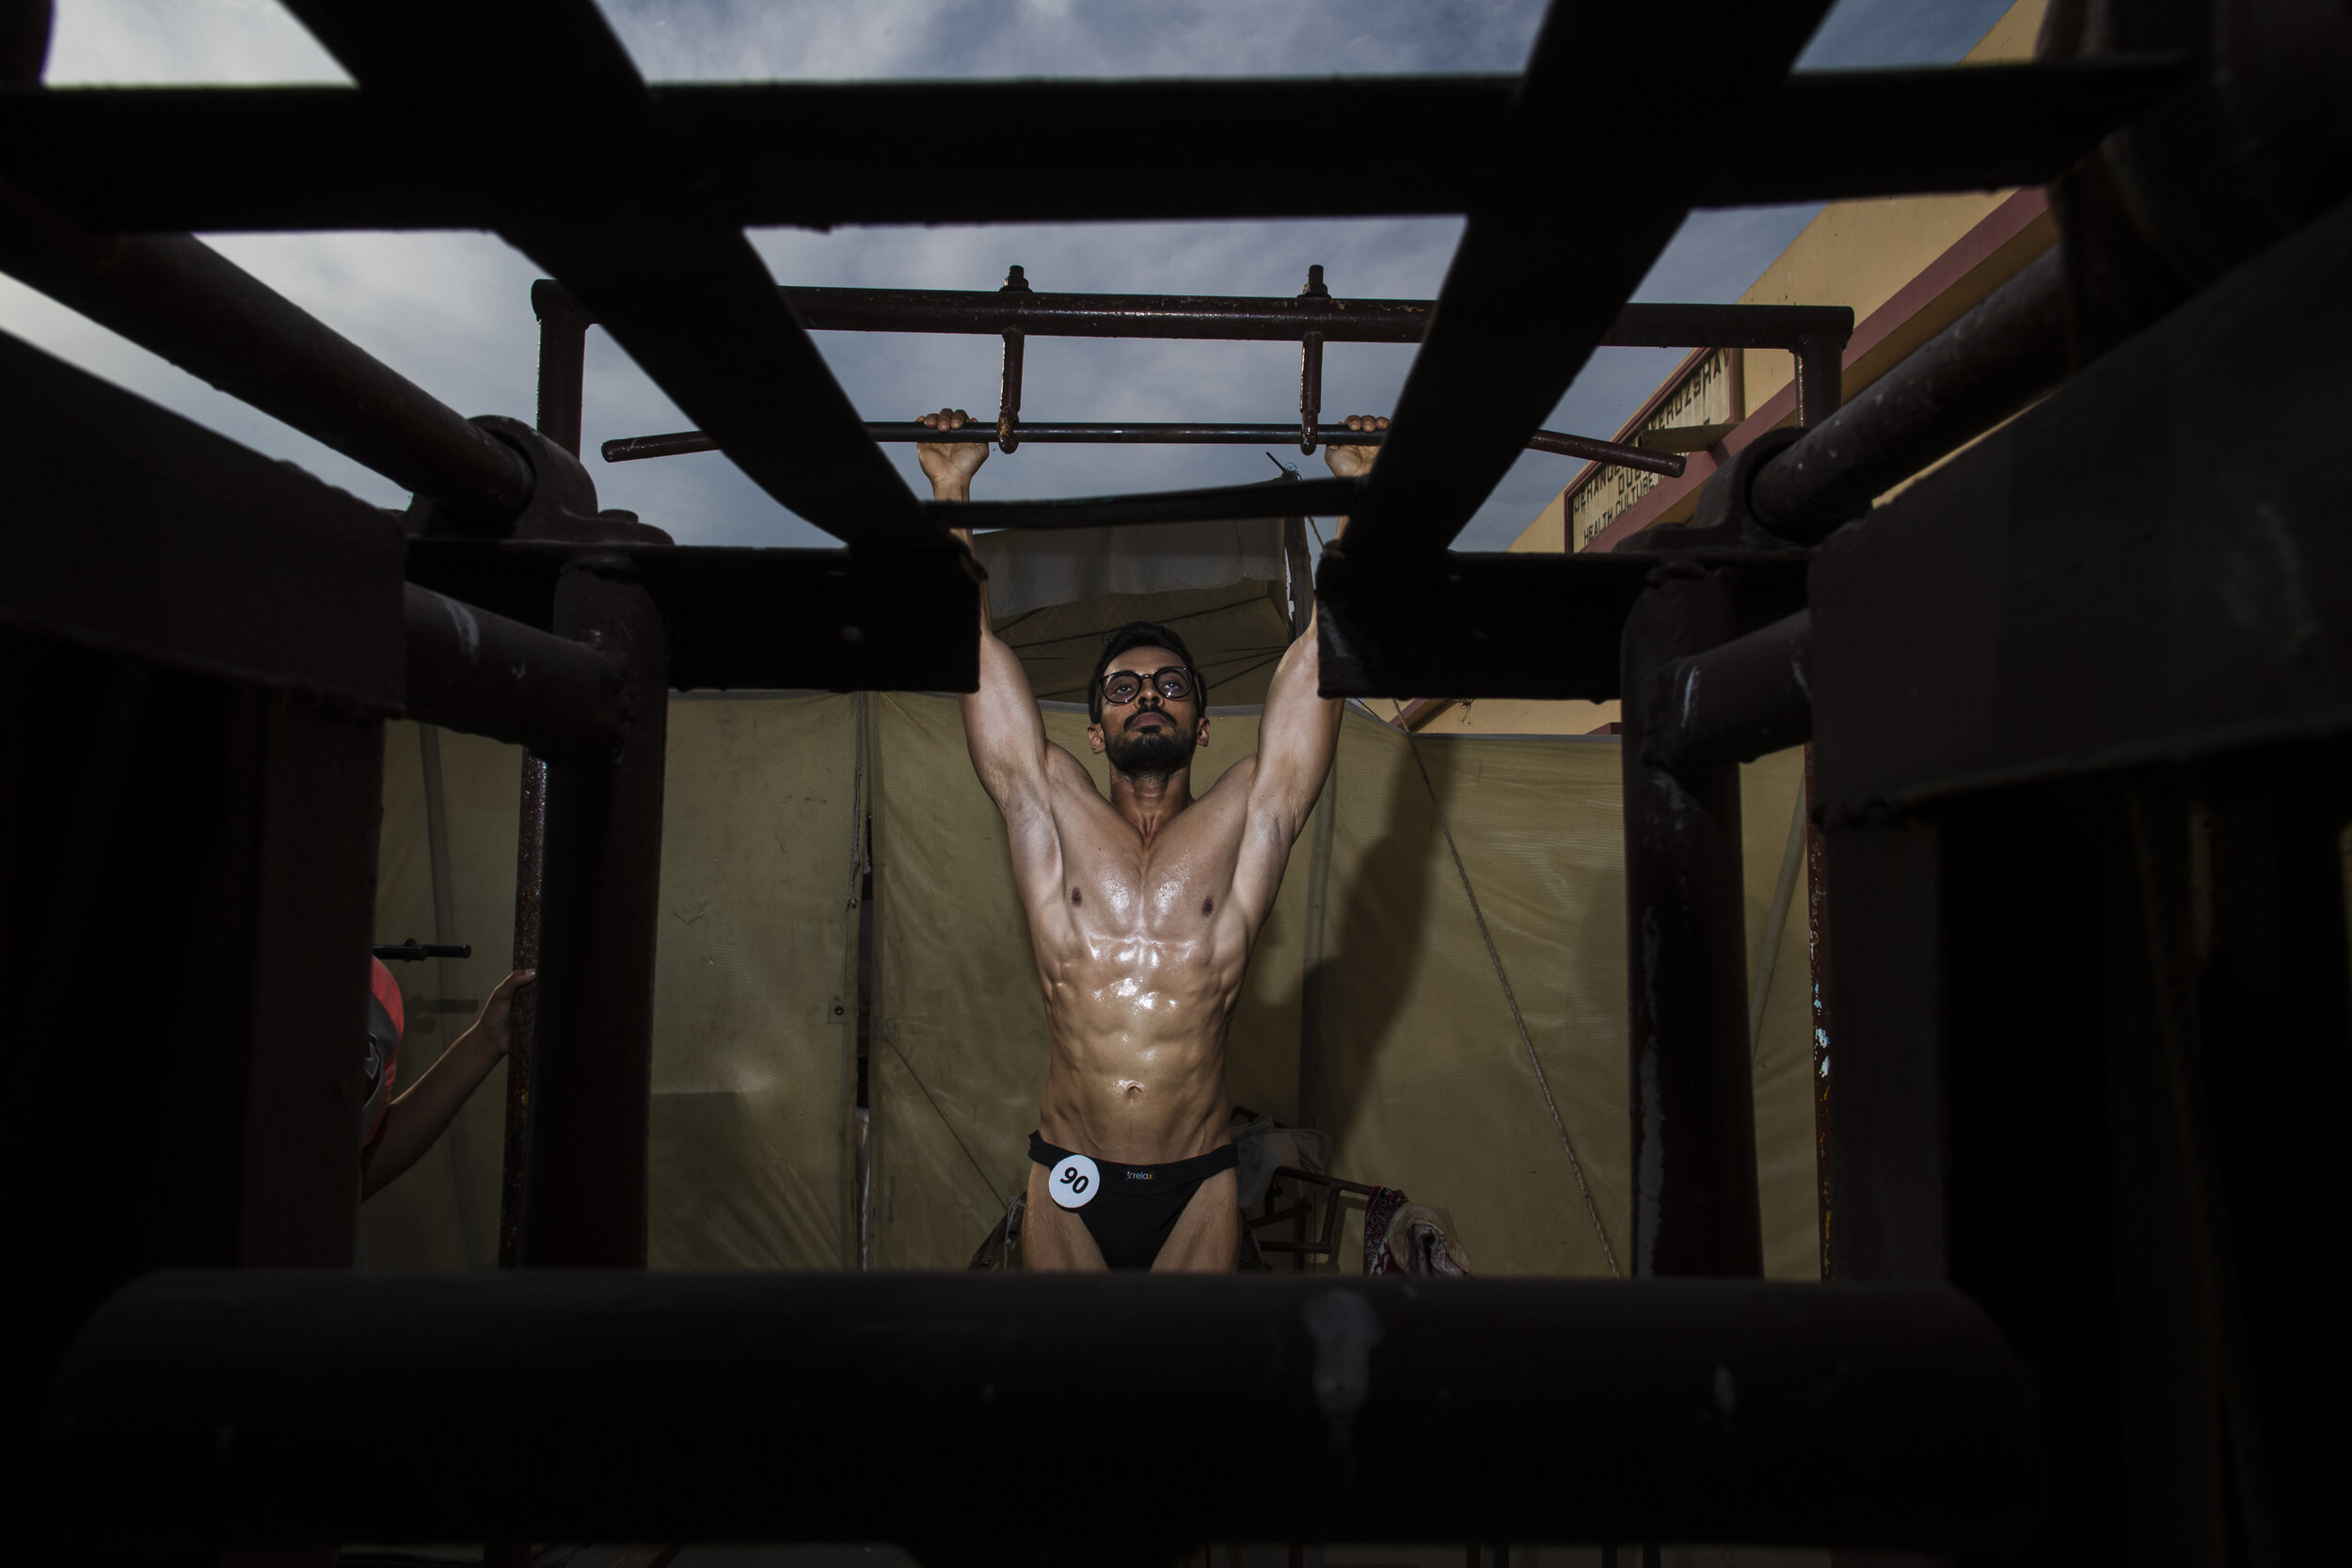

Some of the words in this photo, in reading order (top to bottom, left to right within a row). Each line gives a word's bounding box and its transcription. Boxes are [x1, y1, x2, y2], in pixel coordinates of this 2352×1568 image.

[1583, 507, 1613, 546] HEALTH
[1615, 473, 1654, 516] CULTURE
[1060, 1167, 1089, 1194] 90
